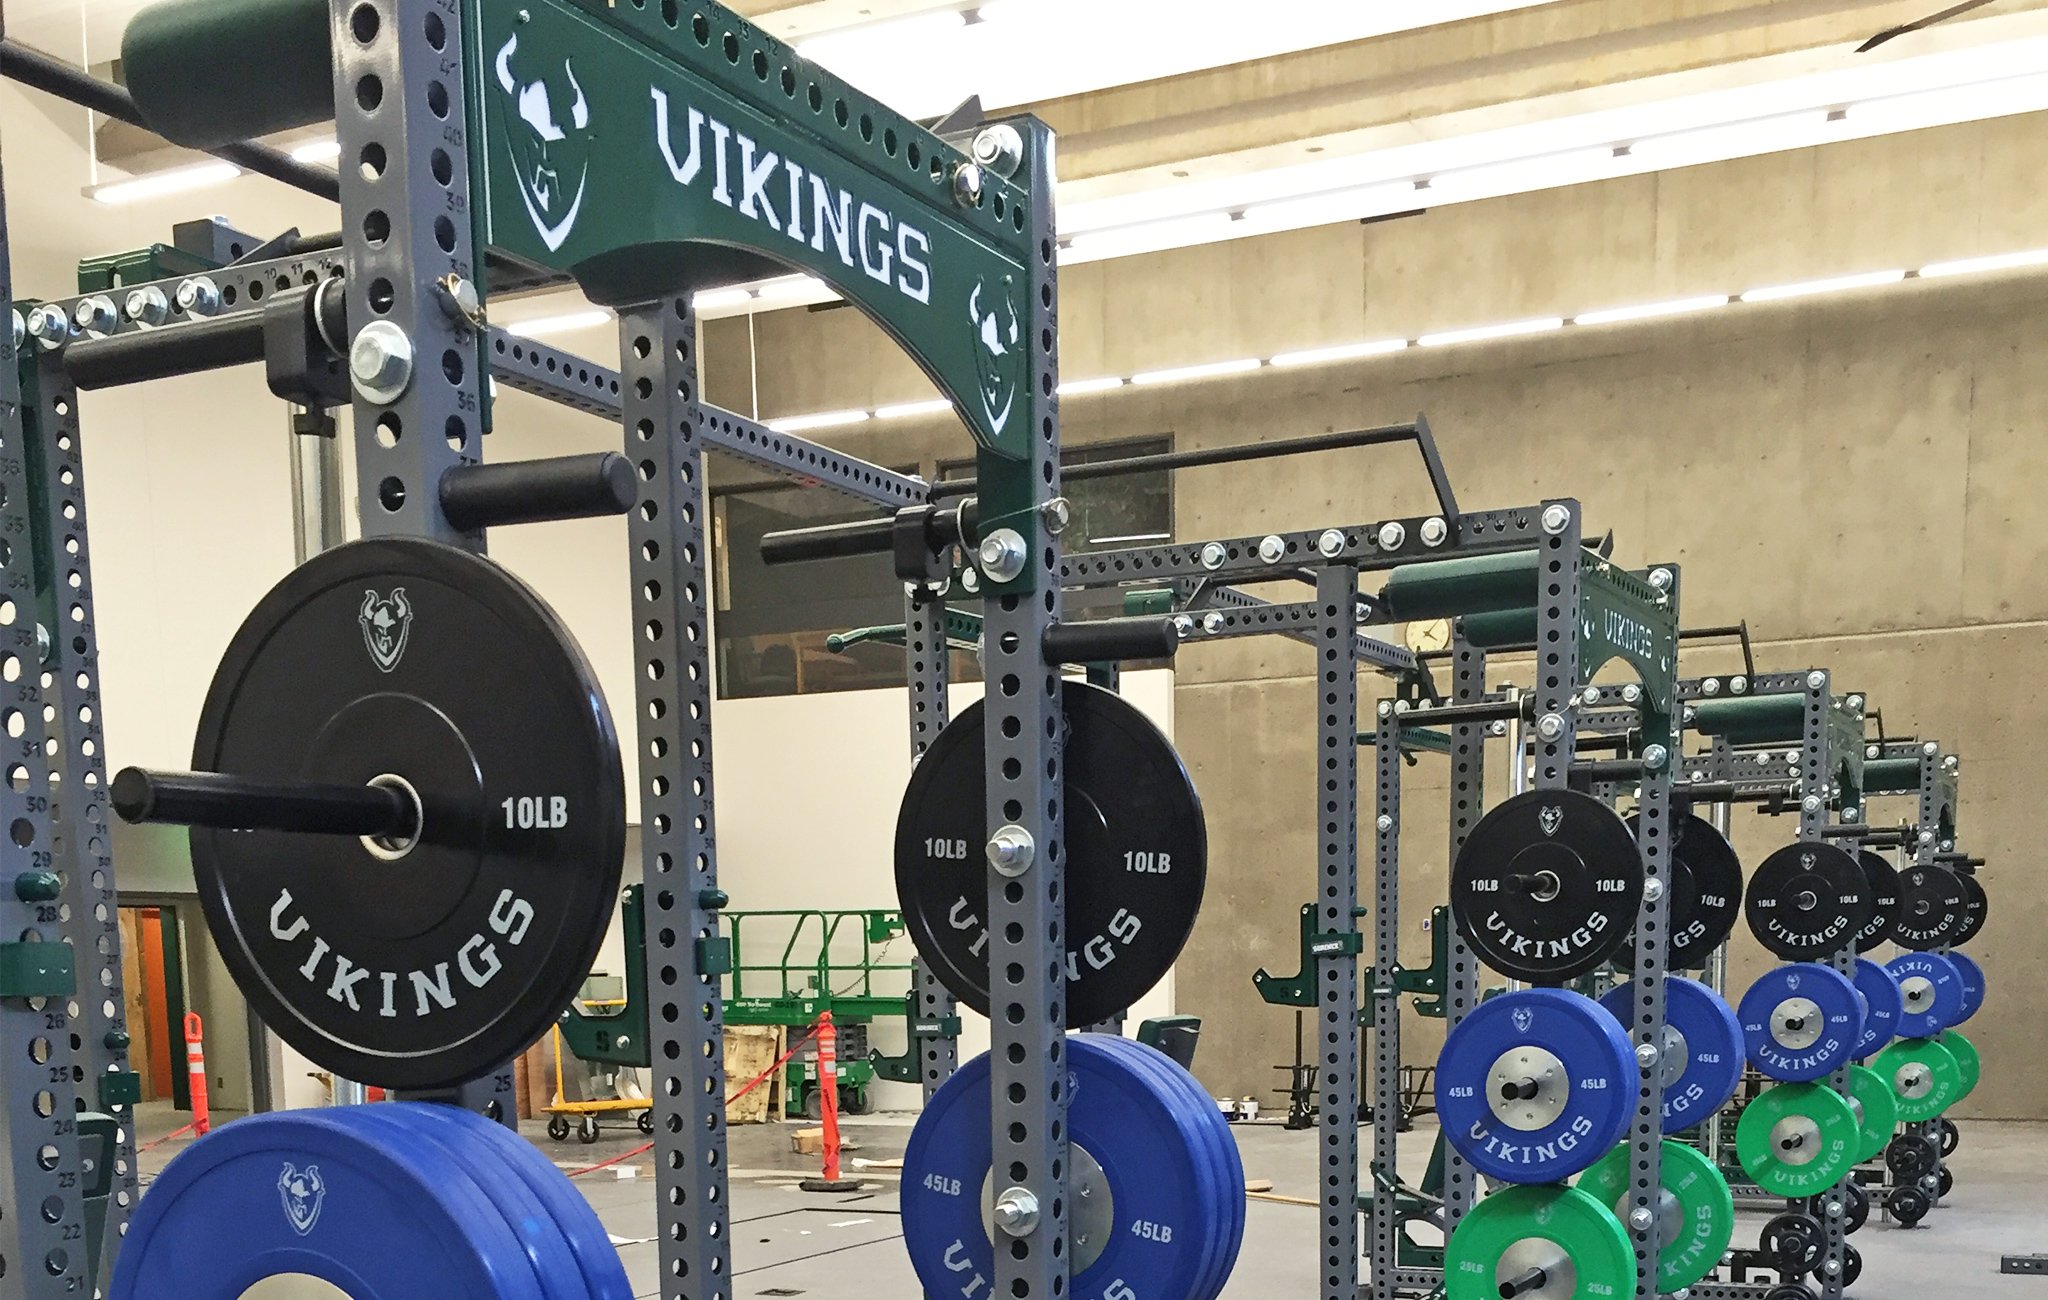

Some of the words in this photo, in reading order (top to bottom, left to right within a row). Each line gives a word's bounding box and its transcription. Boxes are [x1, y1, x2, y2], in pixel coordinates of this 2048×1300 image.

[651, 84, 932, 305] VIKINGS
[291, 263, 304, 275] 11
[318, 257, 332, 270] 12
[264, 267, 277, 280] 10
[456, 389, 476, 412] 36
[16, 628, 33, 647] 33
[1604, 608, 1652, 659] VIKINGS
[18, 686, 38, 702] 32
[21, 740, 42, 758] 31
[26, 796, 48, 813] 30
[501, 796, 567, 830] 10LB
[924, 837, 967, 859] 10LB
[1123, 851, 1171, 874] 10LB
[1470, 879, 1498, 892] 10LB
[1595, 879, 1626, 892] 10LB
[1700, 894, 1726, 908] 10LB
[1757, 899, 1777, 908] 10LB
[1839, 895, 1859, 904] 10LB
[1877, 897, 1896, 906] 10LB
[35, 905, 57, 923] 28
[1486, 910, 1608, 959] VIKINGS
[1768, 915, 1848, 946] VIKINGS
[1897, 913, 1955, 940] VIKINGS
[270, 888, 534, 1017] VIKINGS
[1891, 961, 1933, 977] VIKIN
[45, 1013, 65, 1030] 26
[1697, 1053, 1720, 1064] 45LB
[1759, 1038, 1840, 1070] VIKINGS
[50, 1067, 68, 1083] 25
[494, 1074, 512, 1093] 25
[1448, 1086, 1474, 1098] 45LB
[1581, 1078, 1607, 1090] 45LB
[1895, 1081, 1950, 1114] VIKINGS
[54, 1120, 74, 1136] 24
[1470, 1115, 1593, 1164] VIKINGS
[1774, 1139, 1845, 1186] VIKINGS
[58, 1172, 76, 1188] 23
[923, 1173, 962, 1196] 45LB
[62, 1224, 82, 1240] 22
[1131, 1219, 1172, 1244] 45LB
[1663, 1205, 1712, 1277] KINGS
[1459, 1260, 1484, 1274] 25LB
[65, 1275, 84, 1292] 21
[1587, 1282, 1613, 1296] 25LB
